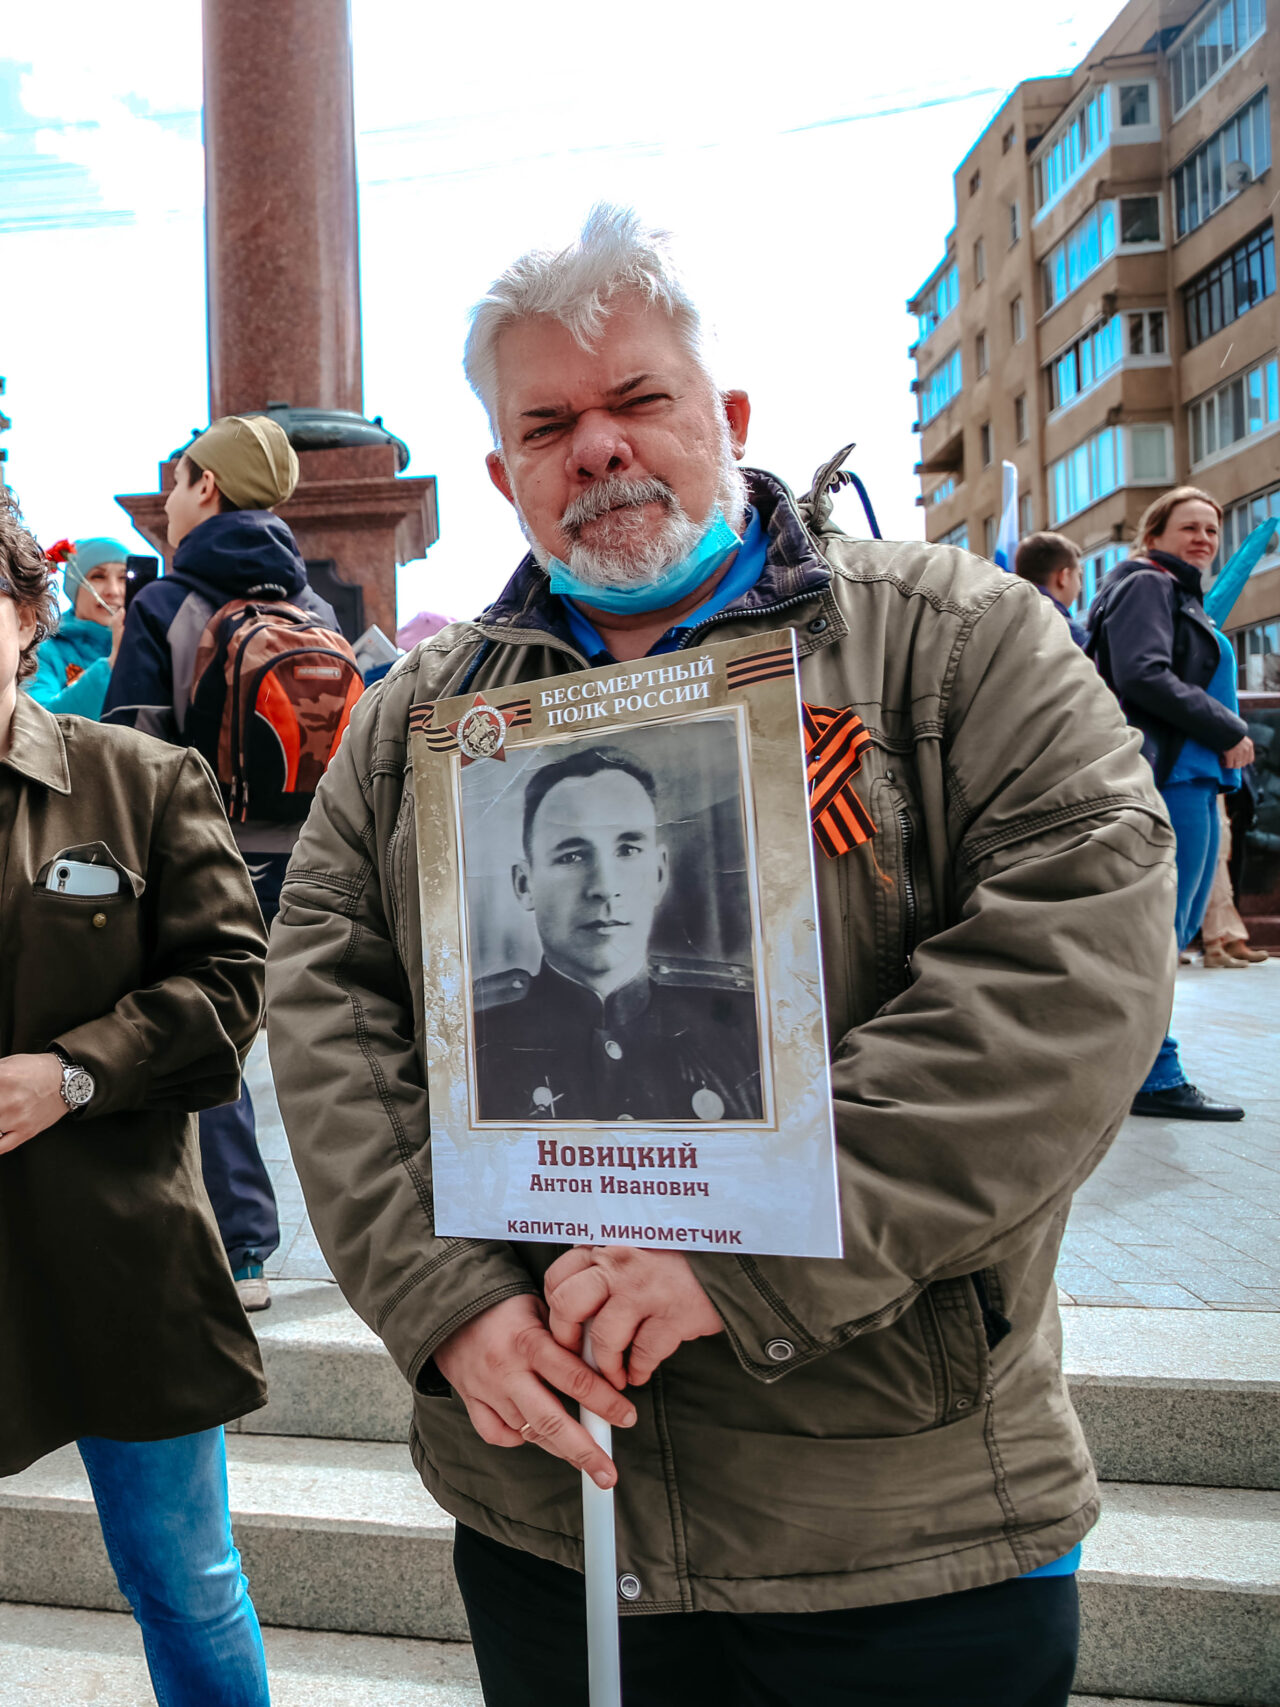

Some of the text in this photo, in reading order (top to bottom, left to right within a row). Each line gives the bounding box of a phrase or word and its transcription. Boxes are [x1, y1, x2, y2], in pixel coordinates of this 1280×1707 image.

[540, 655, 715, 708] БЕССМЕРТНЫЙ
[547, 682, 711, 727] ПОЛК РОССИИ
[537, 1140, 698, 1171] Новицкий
[529, 1174, 710, 1197] Антон Иванович
[507, 1219, 742, 1245] капитан, минометчик
